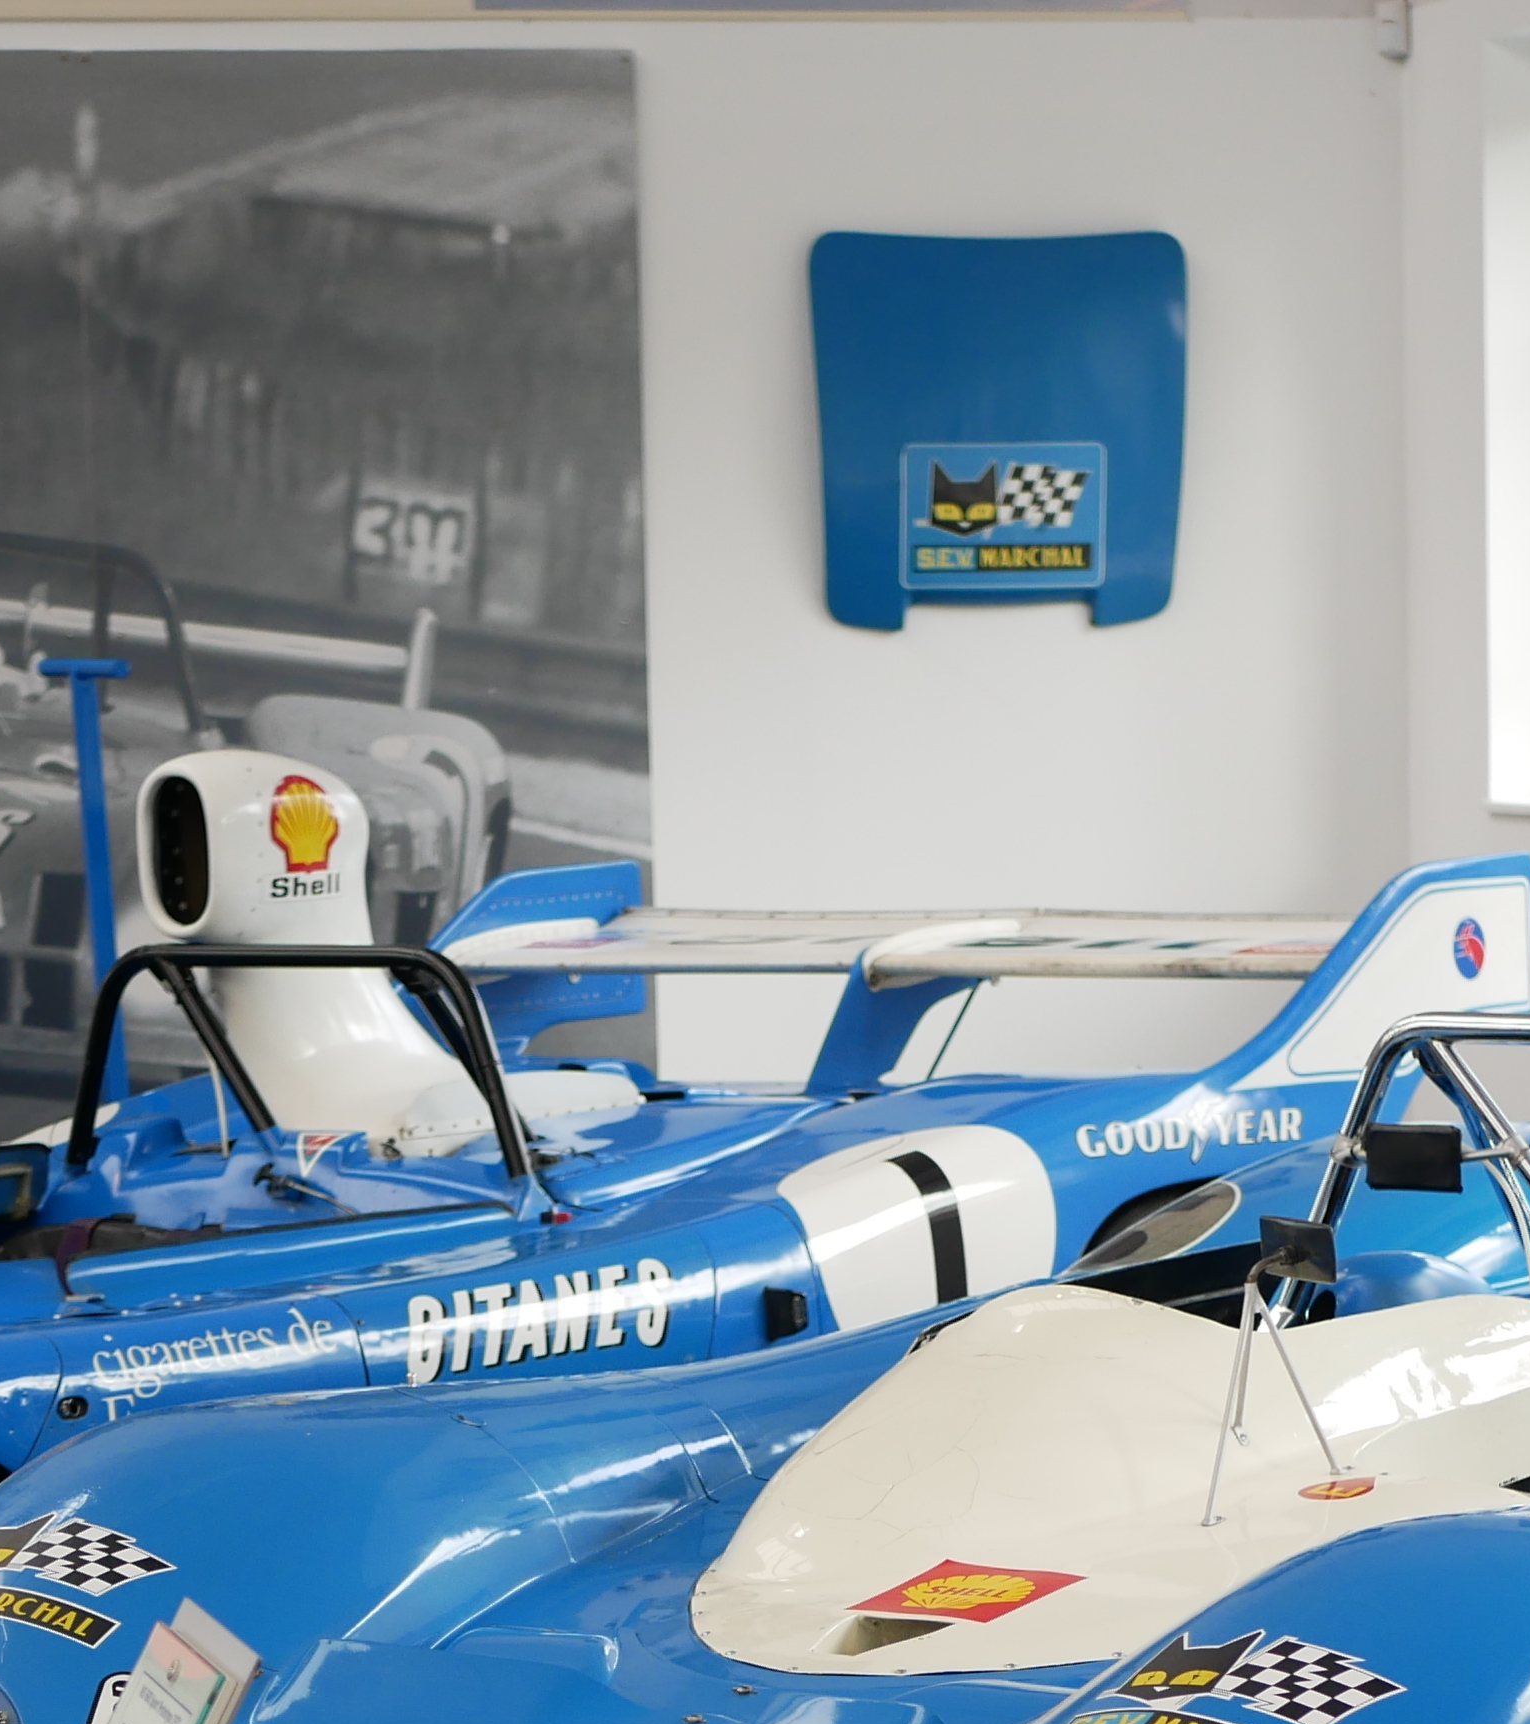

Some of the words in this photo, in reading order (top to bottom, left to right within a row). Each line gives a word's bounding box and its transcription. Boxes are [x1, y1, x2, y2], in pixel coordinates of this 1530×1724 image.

[979, 545, 1085, 567] MARCHAL
[271, 874, 341, 898] Shell
[889, 1150, 969, 1303] 1
[406, 1257, 670, 1385] GITANES
[93, 1326, 276, 1398] cigarettes
[288, 1308, 336, 1352] de
[924, 1580, 1010, 1600] SHELL
